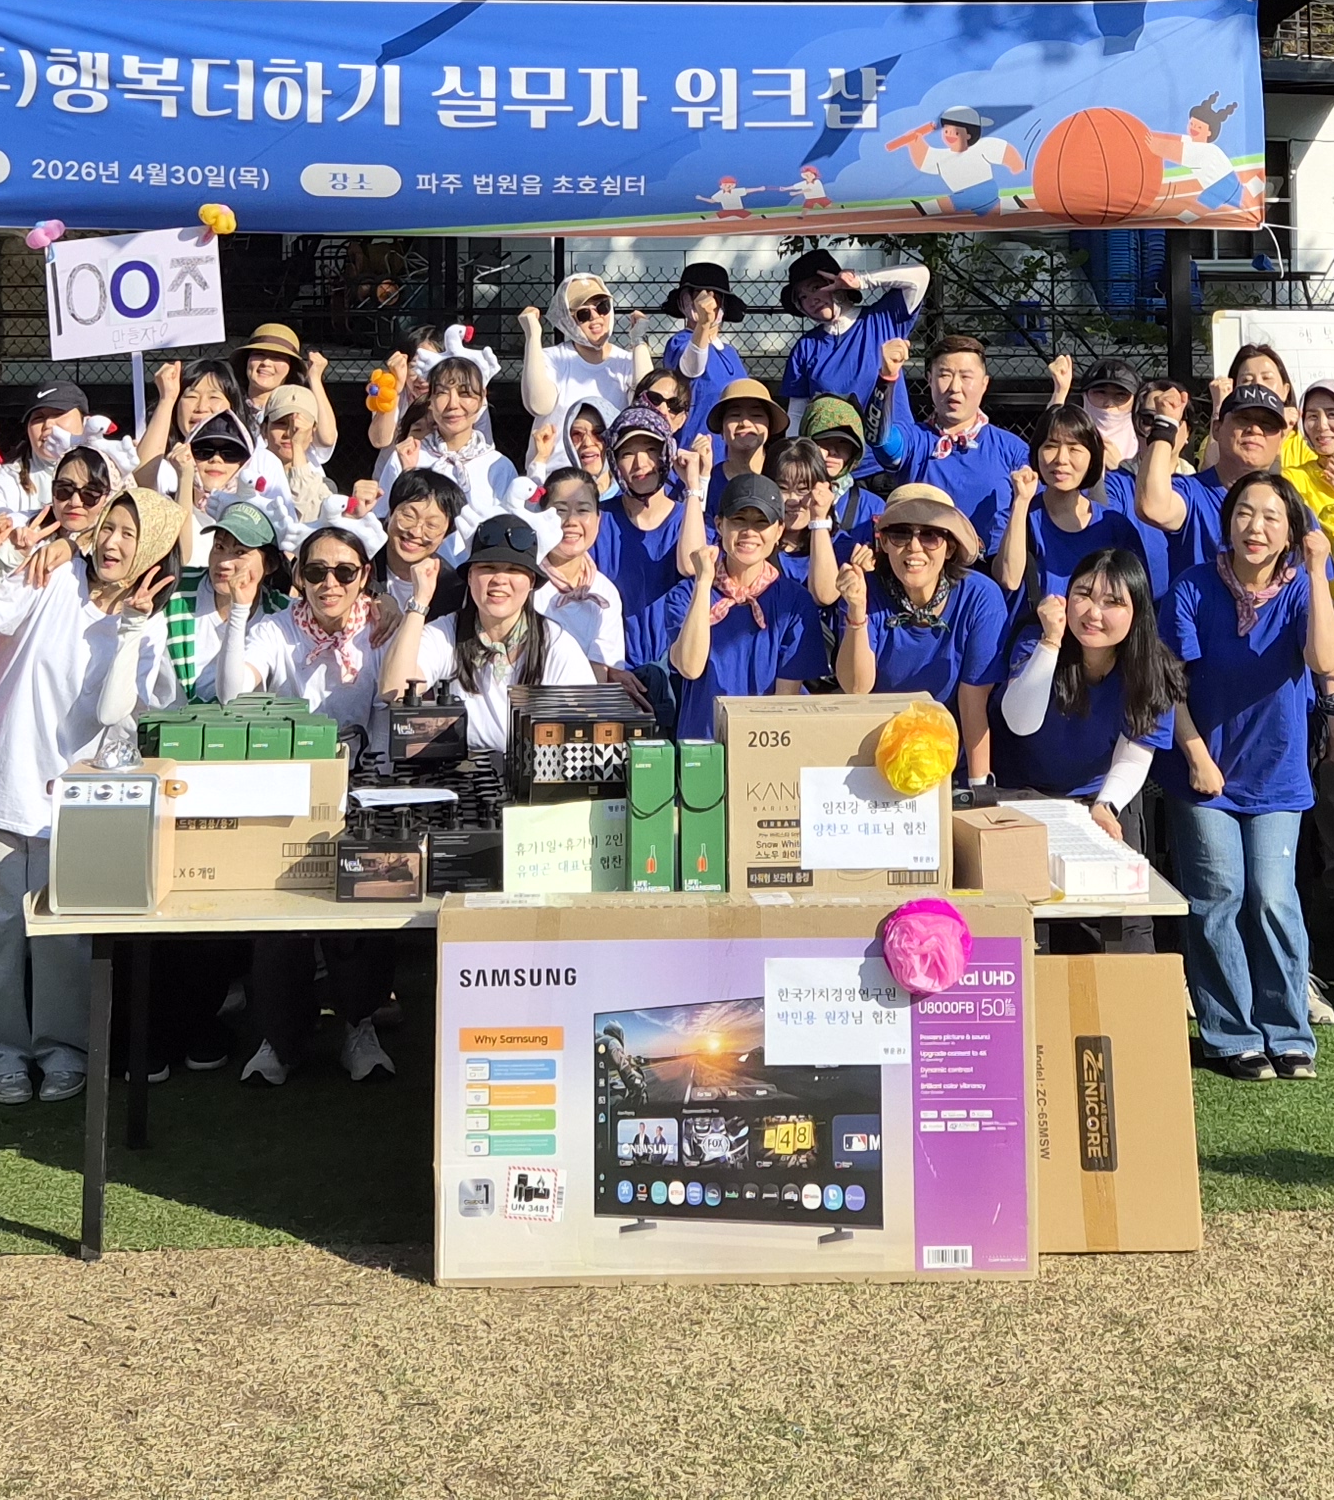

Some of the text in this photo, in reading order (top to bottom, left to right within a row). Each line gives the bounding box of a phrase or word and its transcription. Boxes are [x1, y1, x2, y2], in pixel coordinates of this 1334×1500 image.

[431, 64, 648, 131] 실무자
[670, 65, 888, 132] 워크샵
[31, 158, 269, 191] 2026년 4월30일(목)
[328, 171, 374, 191] 장소
[416, 172, 646, 197] 파주 법원읍 초호쉼터
[50, 256, 219, 336] 100조
[111, 323, 169, 350] 만들자!
[1244, 389, 1278, 409] NYC
[748, 730, 791, 748] 2036
[822, 800, 859, 815] 임진강
[857, 822, 895, 836] 대표님
[903, 821, 927, 836] 협찬
[756, 841, 779, 849] Snow
[189, 868, 195, 878] 6
[197, 867, 216, 880] 개입
[459, 967, 577, 988] SAMSUNG
[982, 971, 1016, 986] UHD
[777, 986, 897, 1002] 한국가치경영연구원
[918, 1001, 974, 1015] U8000FB
[825, 1009, 863, 1025] 원장님
[872, 1009, 898, 1025] 협찬
[474, 1034, 548, 1046] Why Samsung
[1082, 1049, 1103, 1159] ZENICORE
[1036, 1089, 1050, 1160] ZC-65MSW
[707, 1138, 723, 1148] FOX
[510, 1203, 550, 1213] UN 3481
